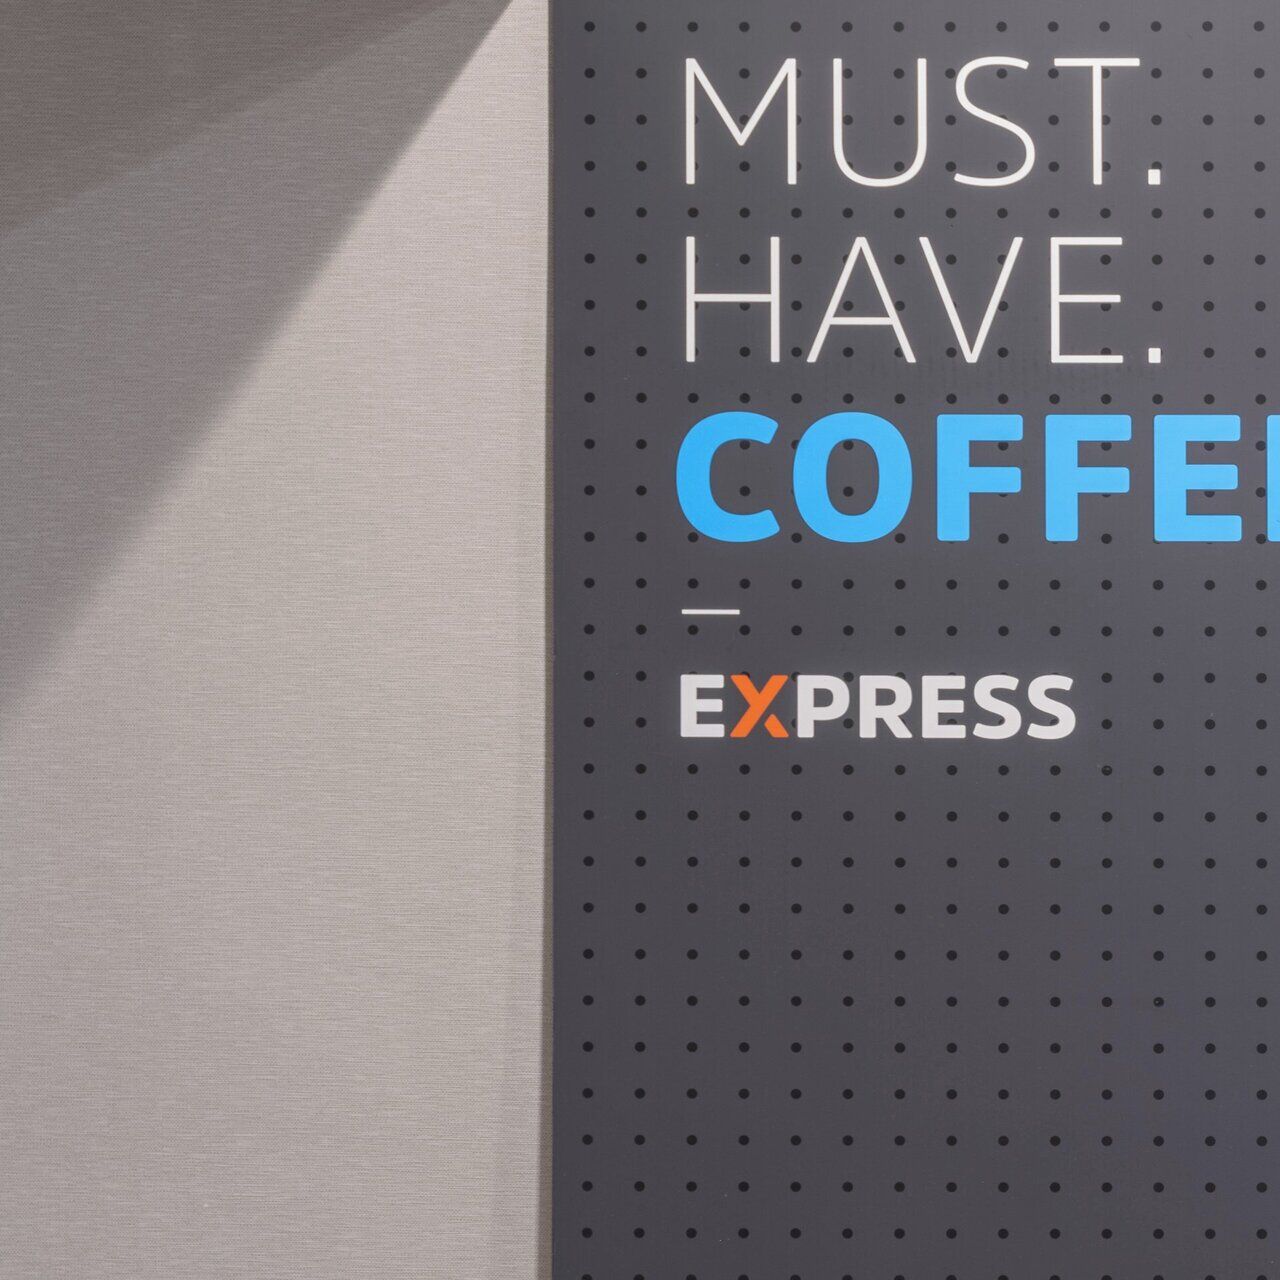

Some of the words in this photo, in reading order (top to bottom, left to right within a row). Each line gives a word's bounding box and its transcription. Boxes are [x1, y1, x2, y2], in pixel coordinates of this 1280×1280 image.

[684, 56, 1162, 188] MUST.
[684, 236, 1162, 364] HAVE.
[679, 674, 1077, 740] EXPRESS
